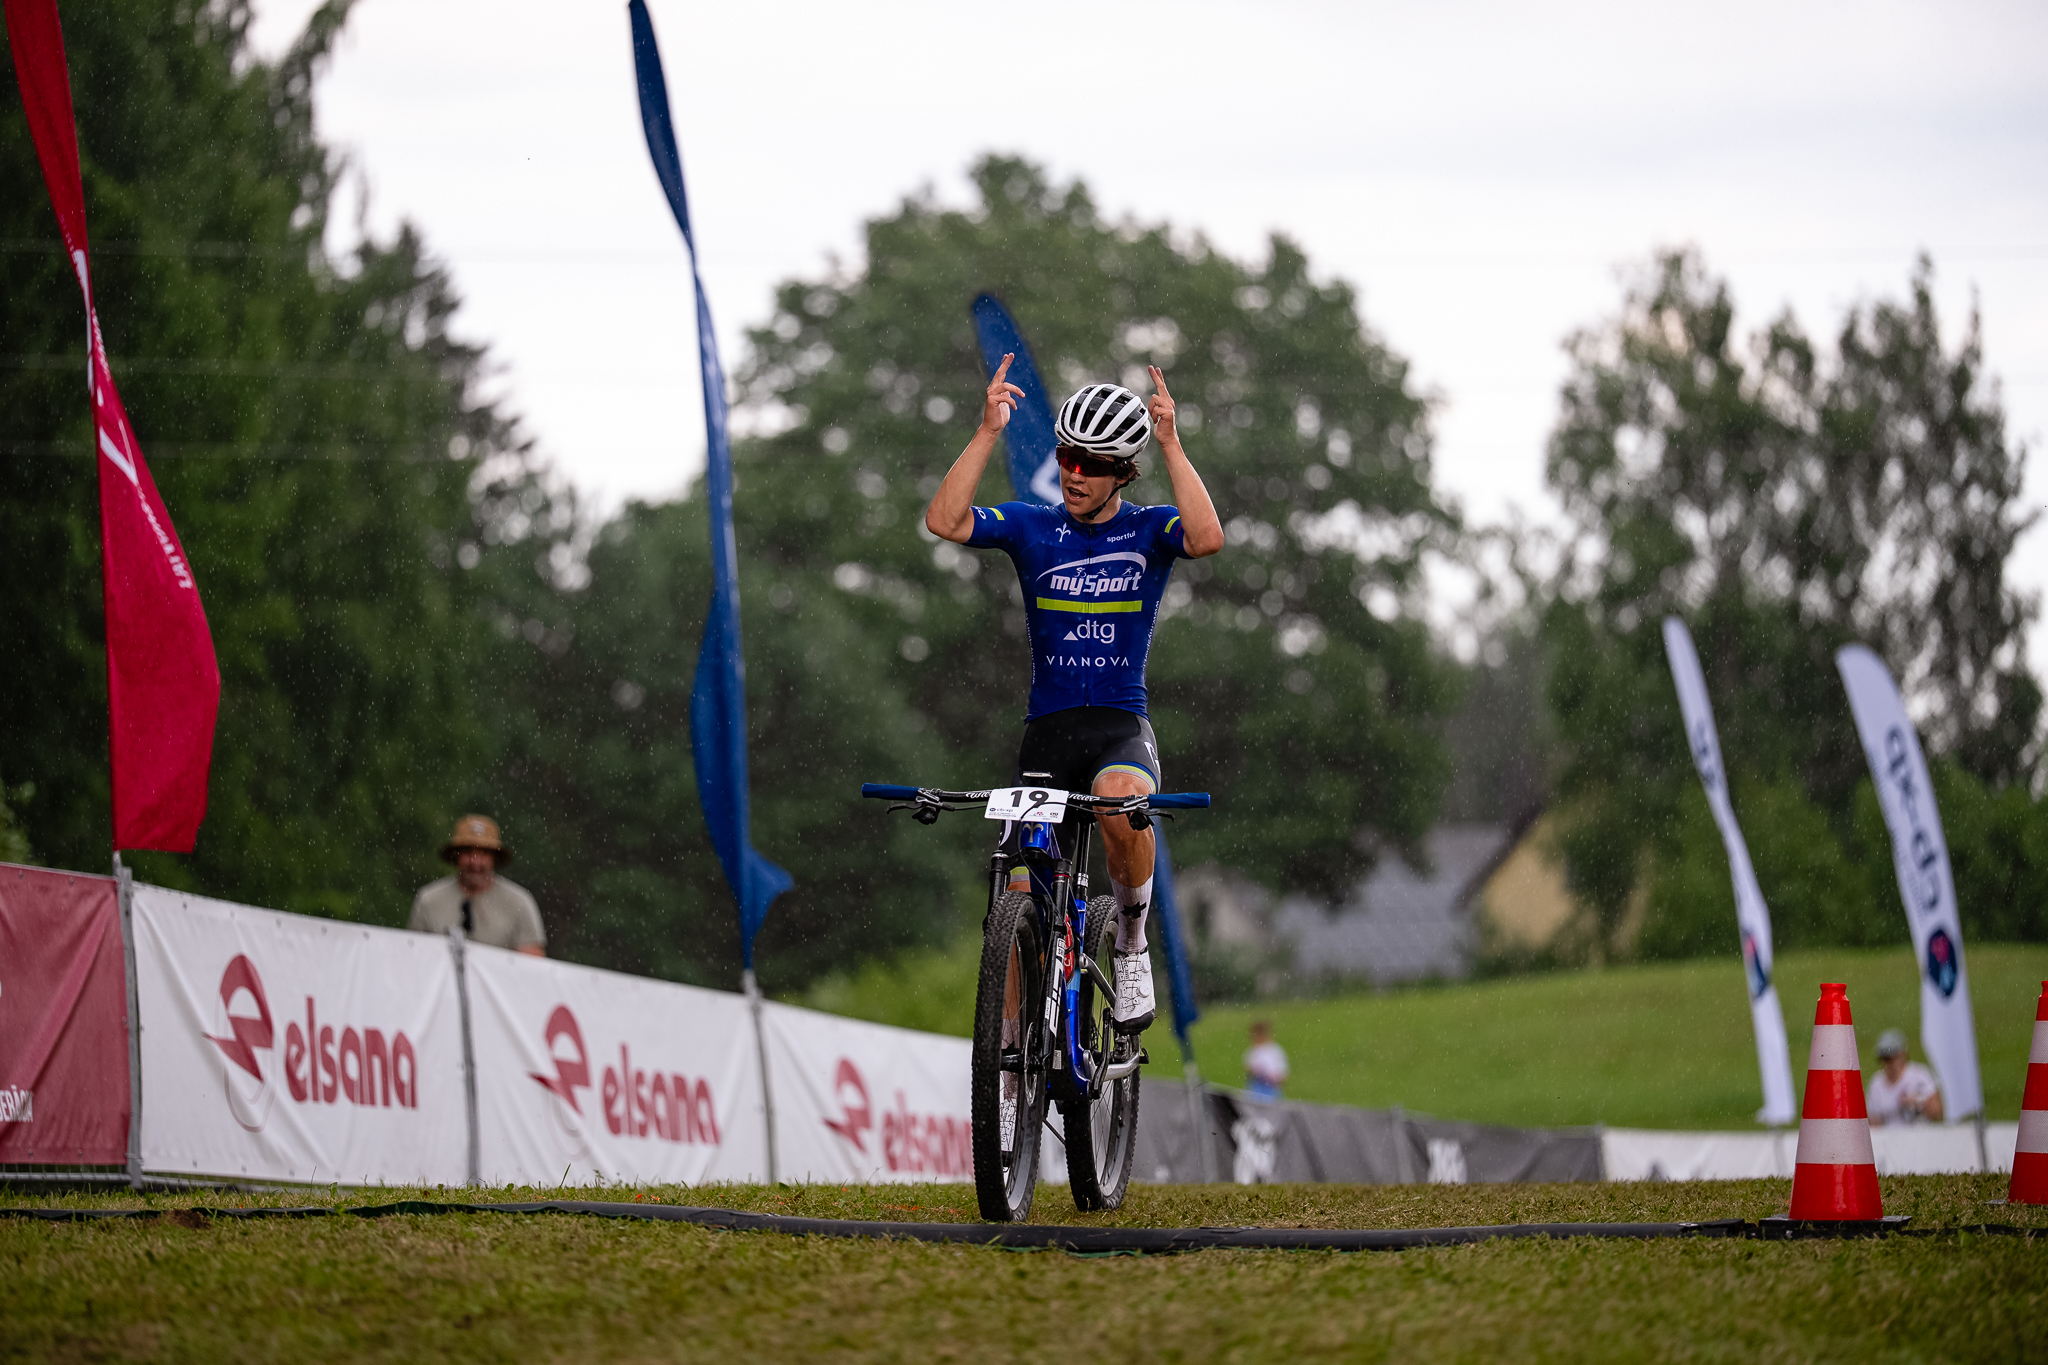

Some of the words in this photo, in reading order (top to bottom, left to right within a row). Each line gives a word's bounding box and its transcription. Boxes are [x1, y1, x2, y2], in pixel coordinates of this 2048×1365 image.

[1106, 530, 1136, 543] sportful
[1050, 571, 1142, 597] mySport
[1076, 619, 1115, 644] dtg
[1046, 655, 1129, 667] VIANOVA
[1010, 790, 1050, 809] 19
[284, 995, 418, 1110] elsana
[602, 1042, 722, 1146] elsana
